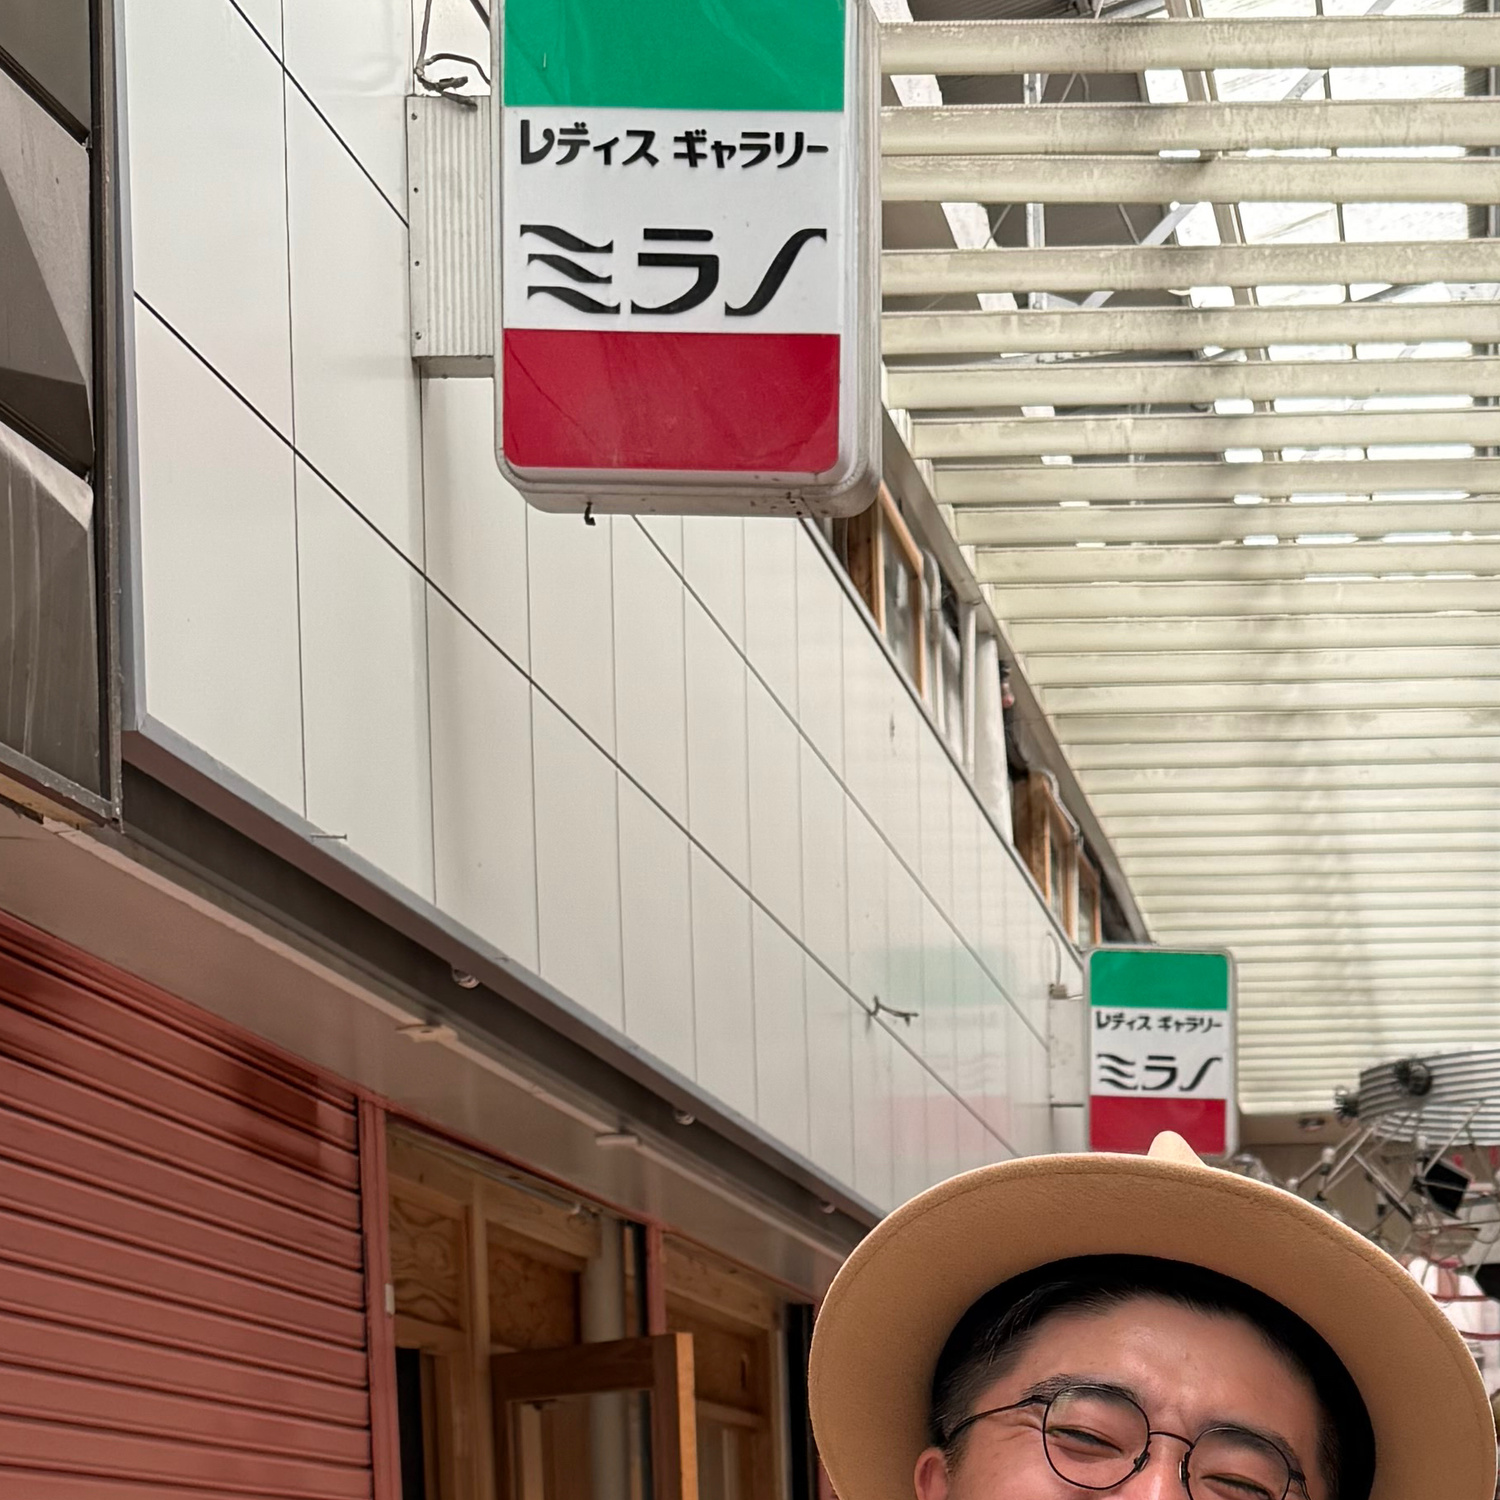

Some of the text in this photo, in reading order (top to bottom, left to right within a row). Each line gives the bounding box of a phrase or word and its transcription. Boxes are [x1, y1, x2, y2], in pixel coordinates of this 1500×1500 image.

[519, 119, 830, 169] レディス ギャラリー
[519, 224, 828, 317] ミラノ
[1095, 1010, 1223, 1033] レディス ギャラリー
[1096, 1053, 1223, 1092] ミラノ
